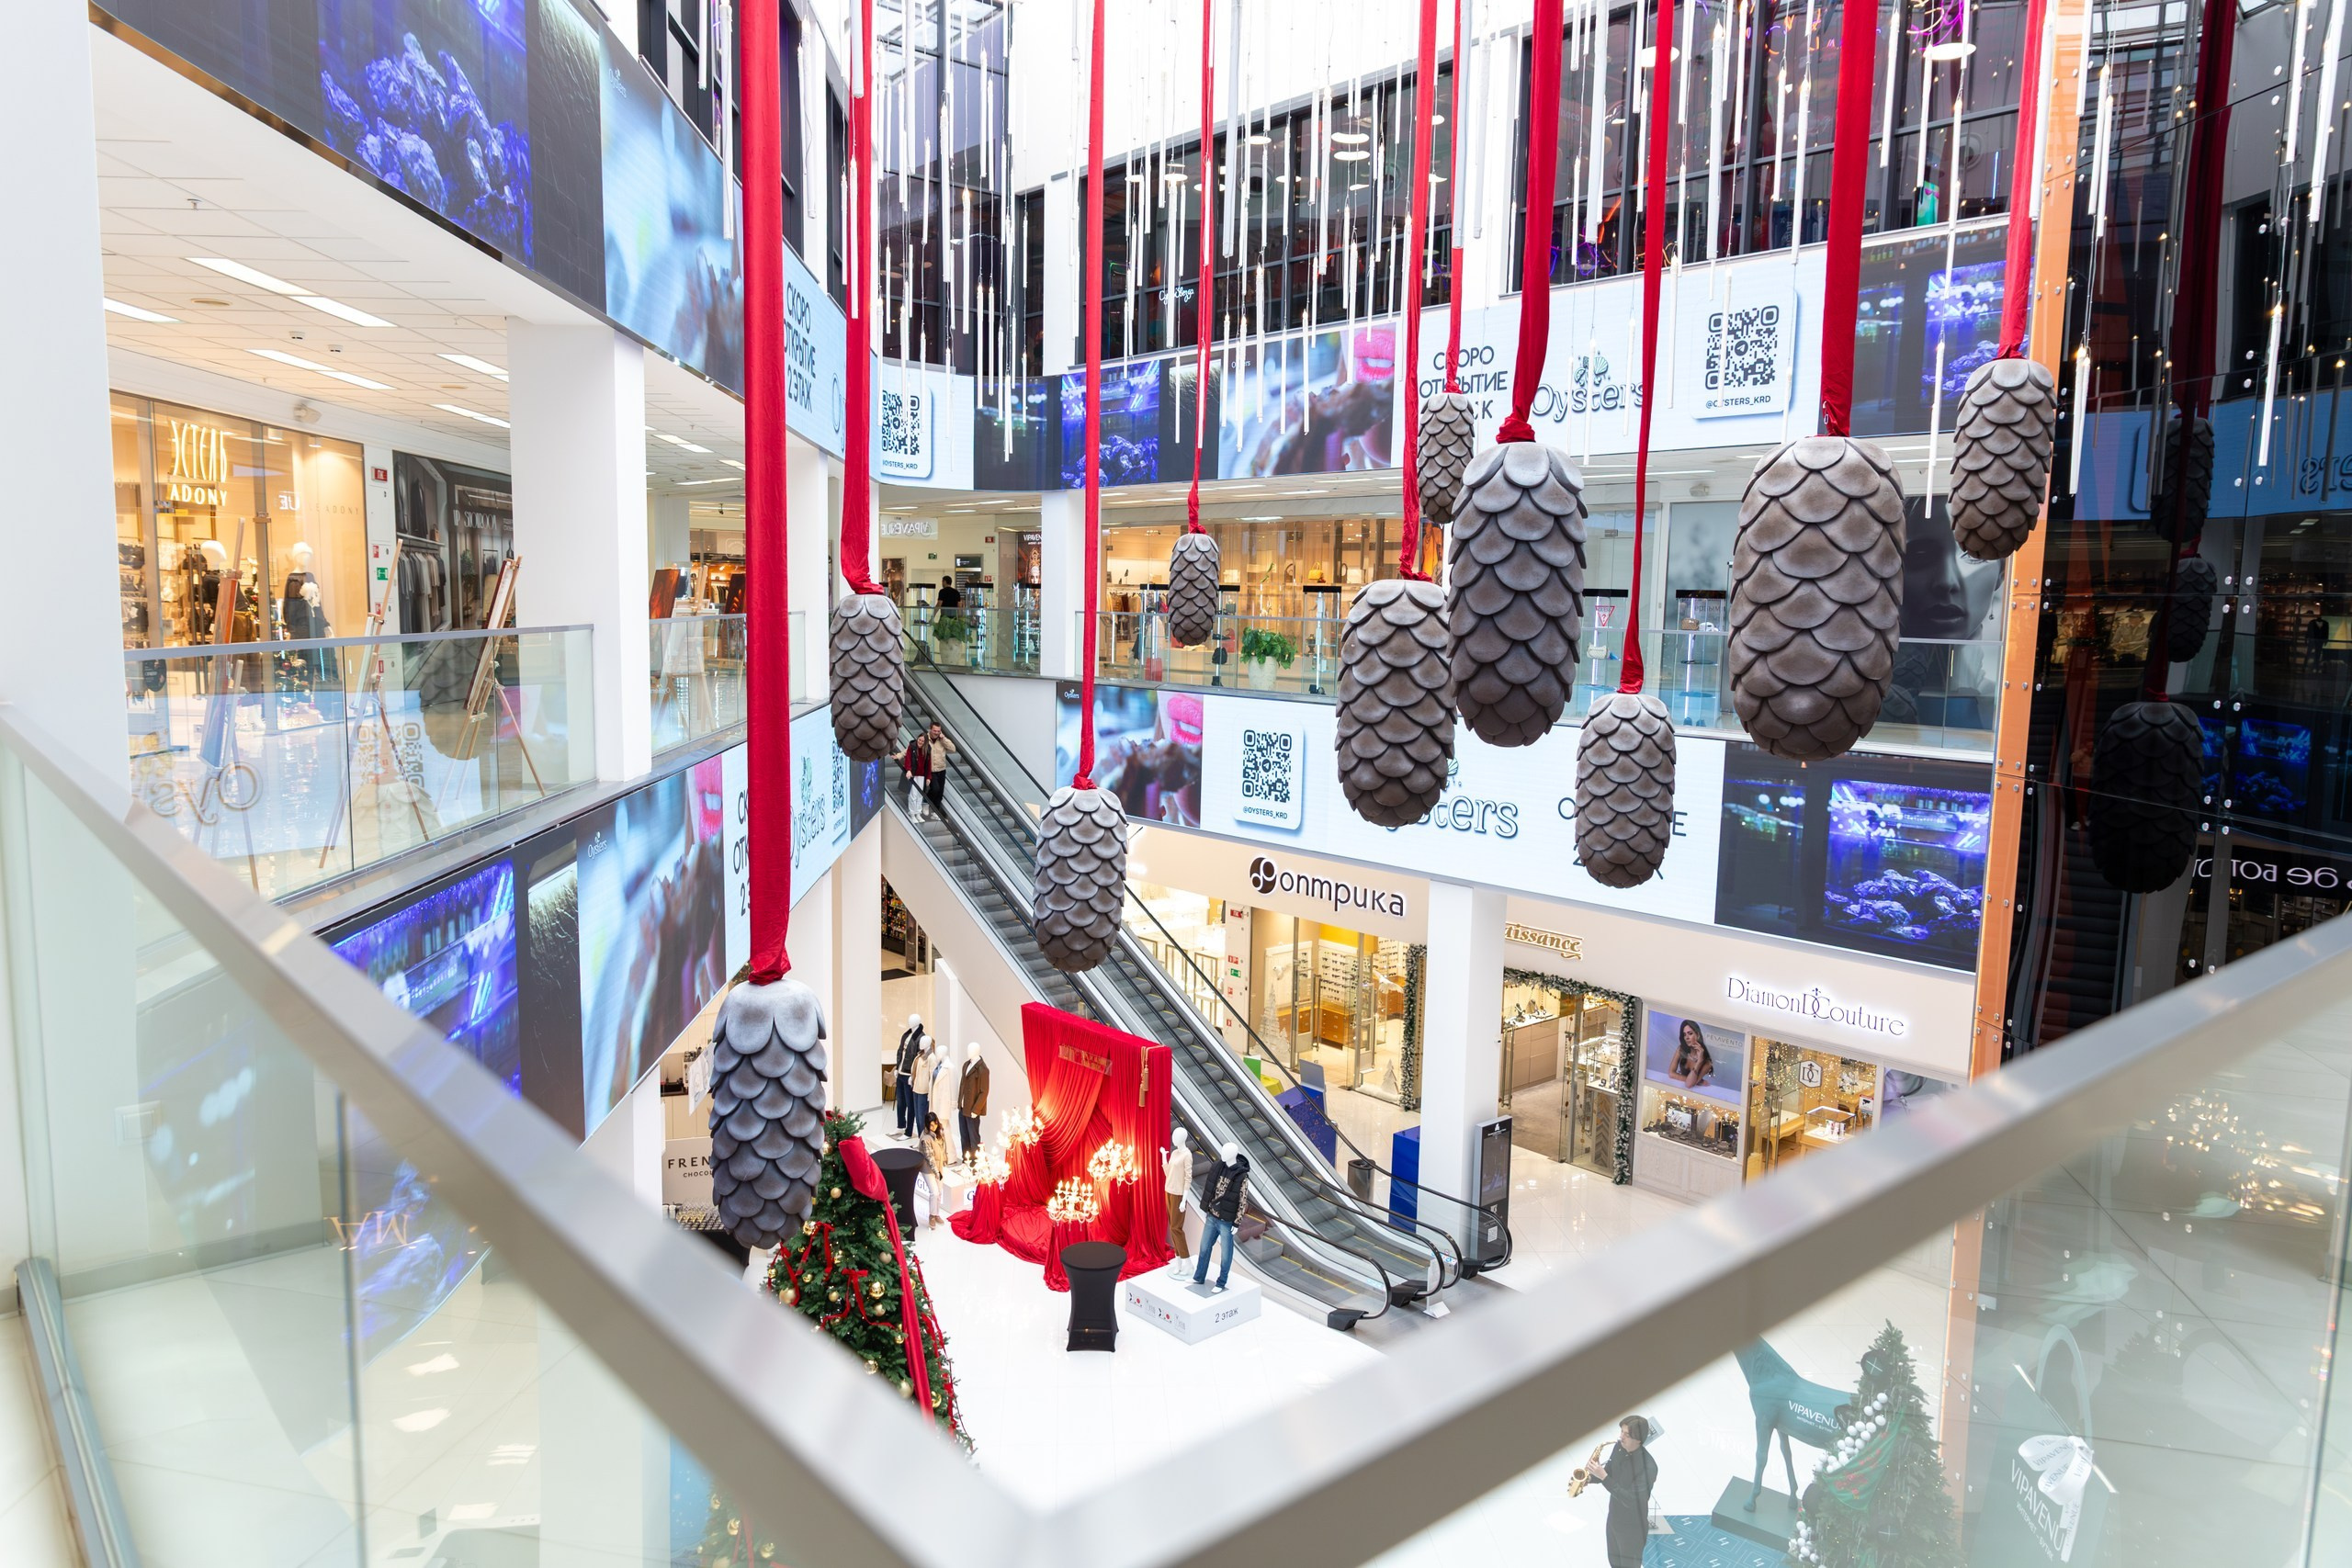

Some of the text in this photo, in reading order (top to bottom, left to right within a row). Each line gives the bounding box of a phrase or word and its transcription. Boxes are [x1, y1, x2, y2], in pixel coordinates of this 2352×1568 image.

[786, 281, 811, 334] СКОРО
[1433, 345, 1495, 370] СОРО
[787, 364, 793, 400] 2
[793, 368, 813, 413] ЭТАЖ
[170, 483, 228, 506] ADONY
[791, 793, 826, 870] ysters
[1215, 1307, 1239, 1324] 2 этаж
[1788, 1400, 1841, 1430] VIPAVENU
